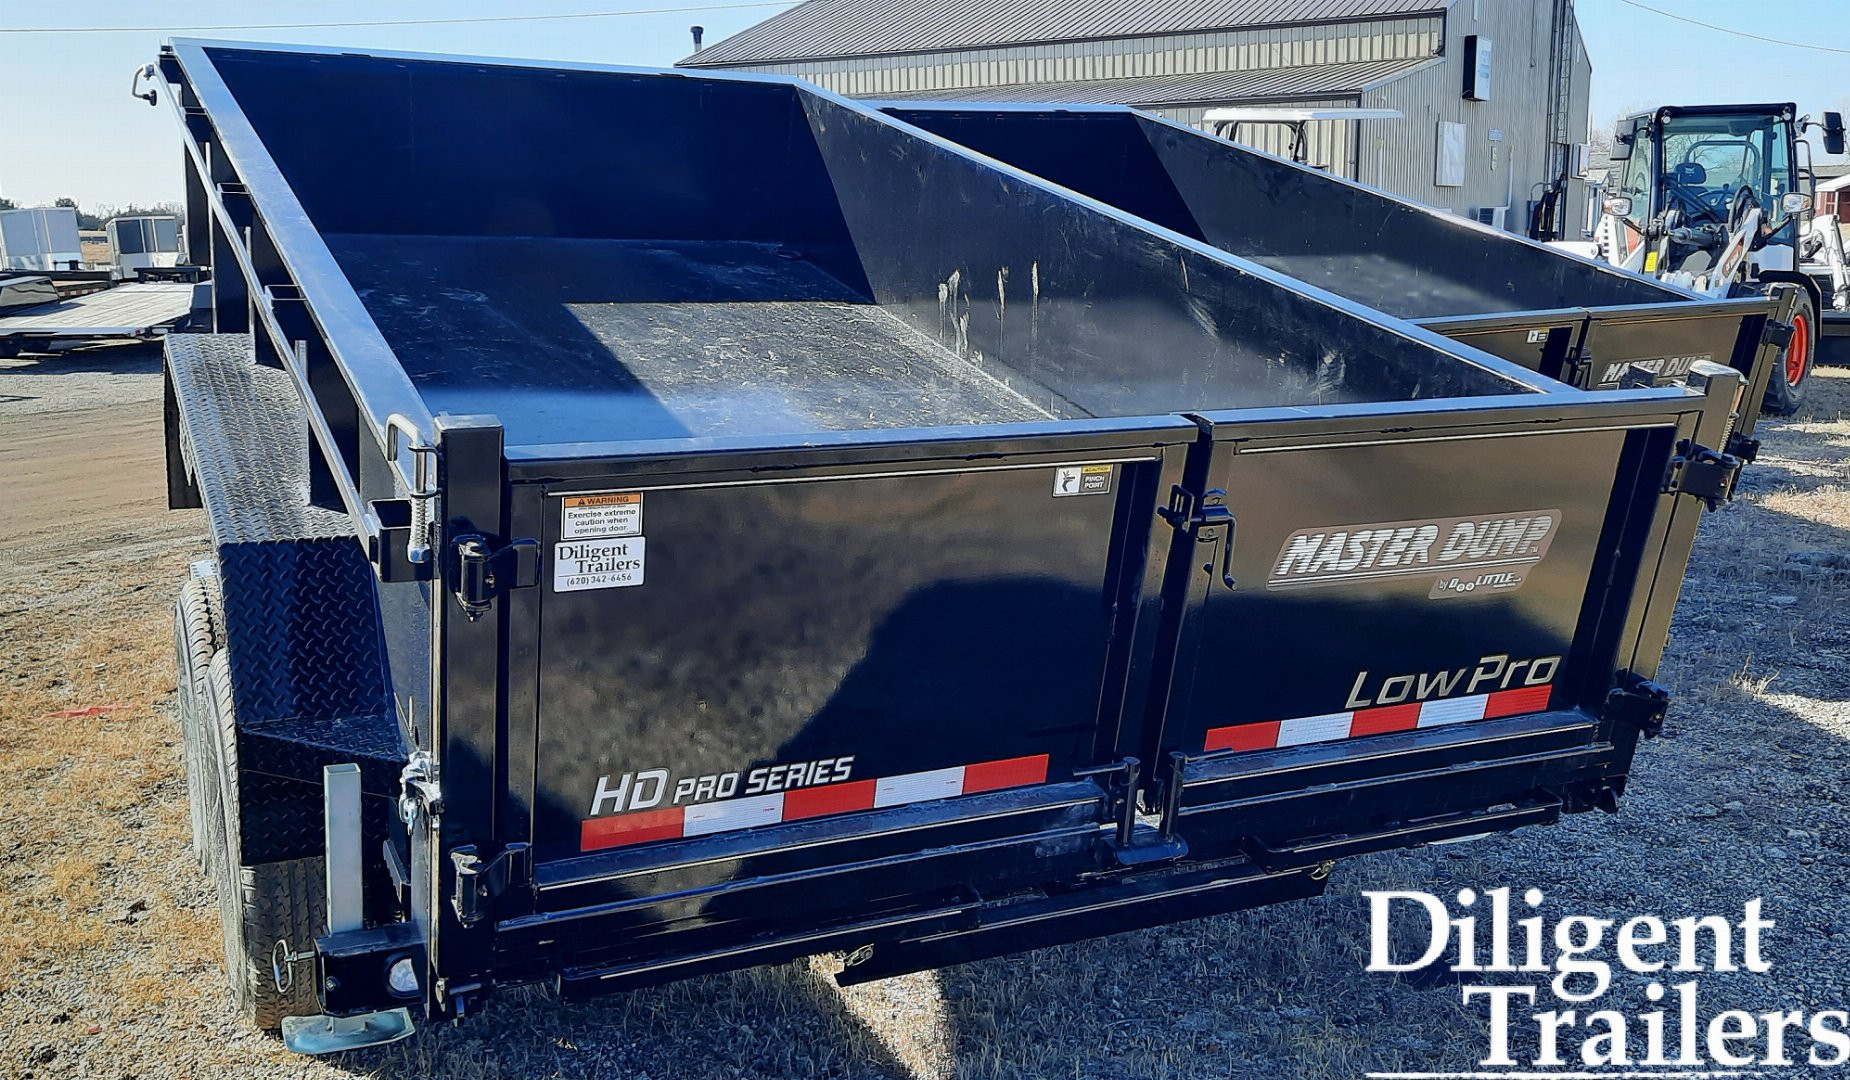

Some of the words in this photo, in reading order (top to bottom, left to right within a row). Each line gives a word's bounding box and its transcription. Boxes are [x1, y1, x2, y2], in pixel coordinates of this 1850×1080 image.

[587, 496, 629, 505] WARNING
[568, 511, 602, 519] Exercise
[604, 509, 636, 517] extreme
[575, 518, 605, 526] caution
[574, 526, 607, 534] opening
[558, 543, 629, 562] Diligent
[1274, 524, 1440, 576] MASTER
[1435, 515, 1553, 562] DUMP
[574, 557, 641, 573] Trailers
[1438, 579, 1449, 591] by
[1345, 668, 1468, 709] Low
[1466, 653, 1562, 693] Pro
[589, 767, 669, 816] HD
[673, 771, 740, 804] PRO
[745, 755, 856, 795] SERIES
